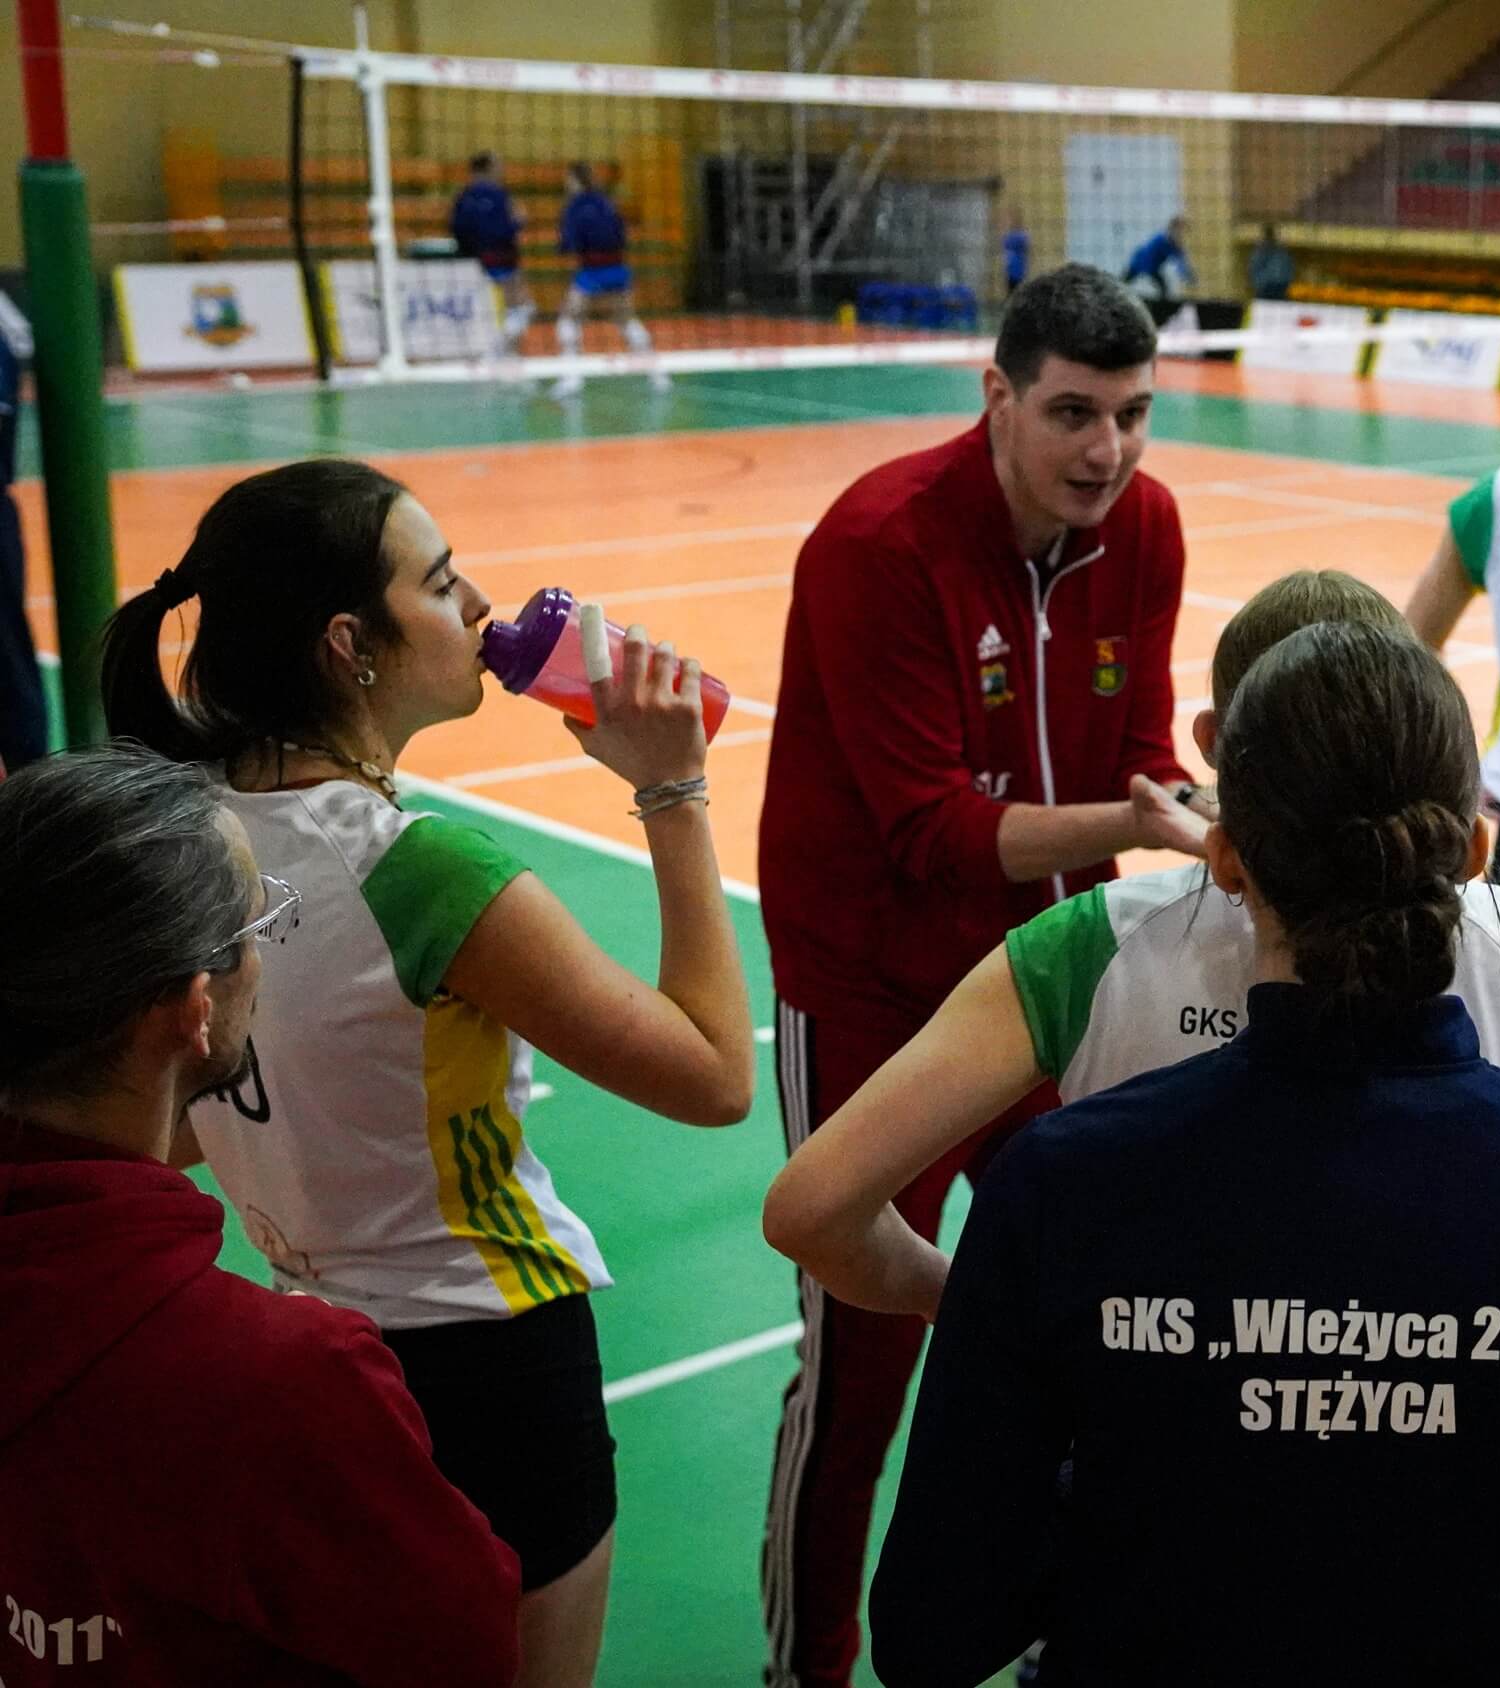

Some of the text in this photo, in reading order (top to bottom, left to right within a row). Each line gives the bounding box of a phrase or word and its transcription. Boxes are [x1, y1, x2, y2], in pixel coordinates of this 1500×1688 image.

[1179, 1006, 1238, 1039] GKS
[1101, 1297, 1195, 1353] GKS
[1207, 1298, 1459, 1362] „Wieżyca
[1239, 1370, 1457, 1441] STĘŻYCA
